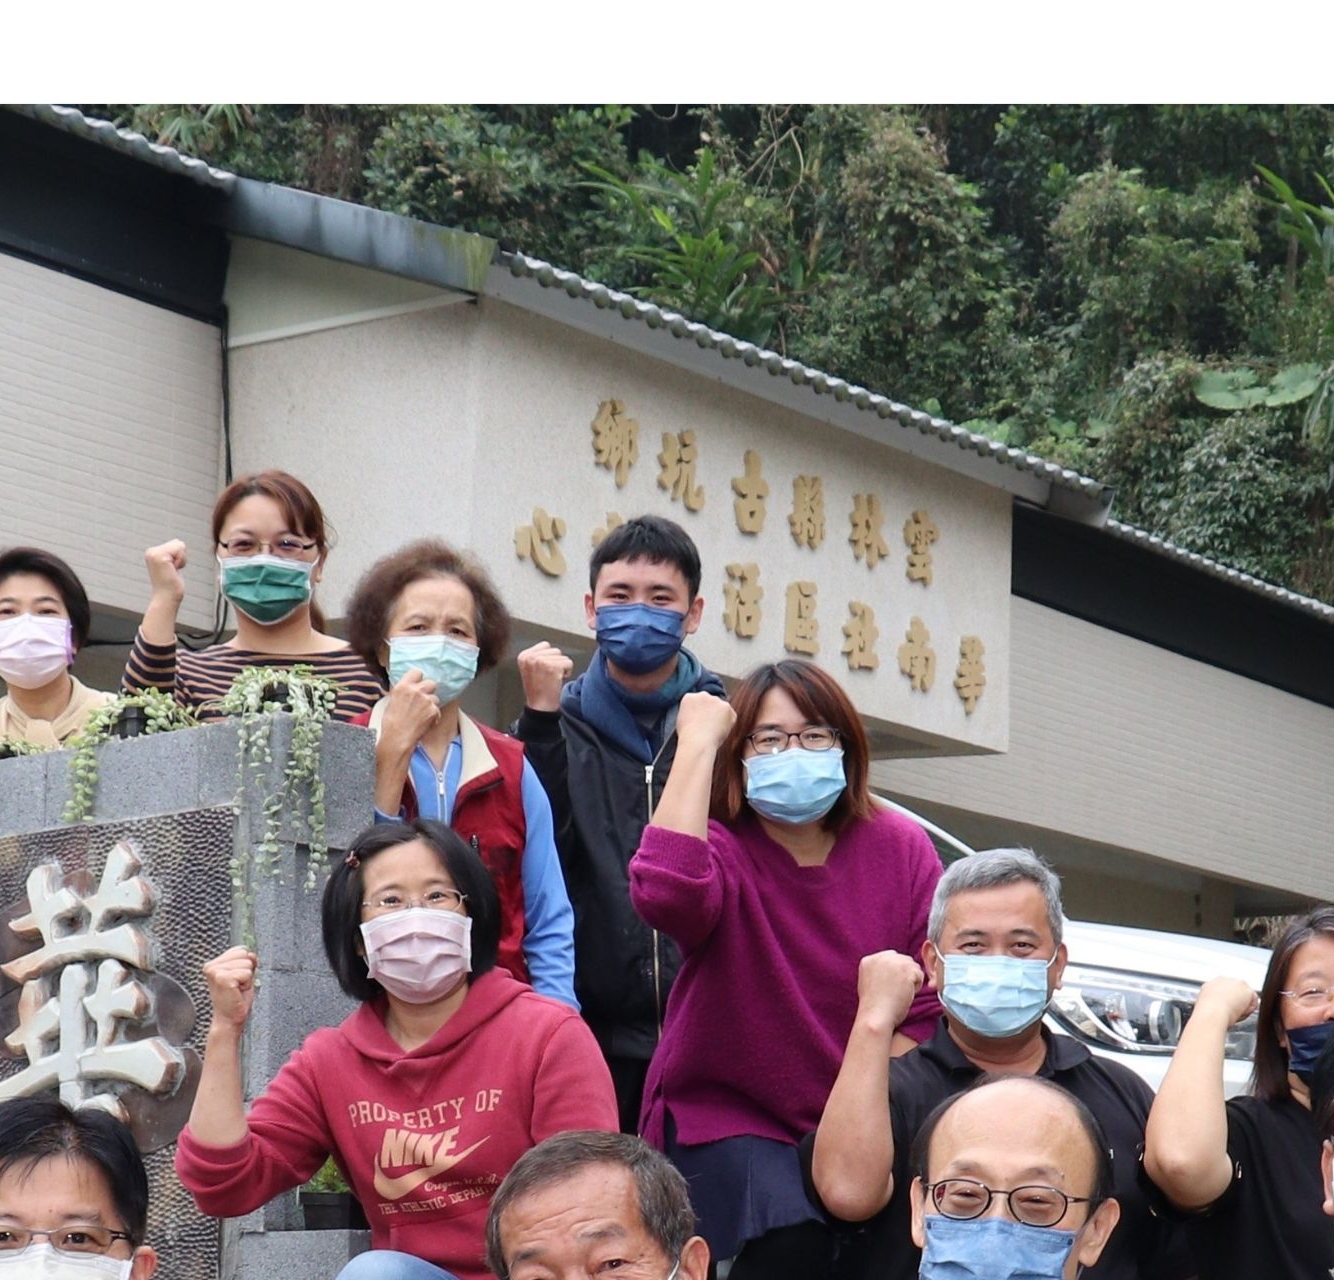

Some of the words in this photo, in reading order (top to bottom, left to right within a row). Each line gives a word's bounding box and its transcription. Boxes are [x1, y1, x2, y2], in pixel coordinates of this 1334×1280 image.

[515, 506, 986, 715] 華南社區活心
[348, 1097, 465, 1128] PROPERTY
[475, 1089, 502, 1113] OF
[381, 1126, 460, 1168] NIKE
[378, 1203, 398, 1215] THE
[400, 1196, 447, 1213] ATHLETIC
